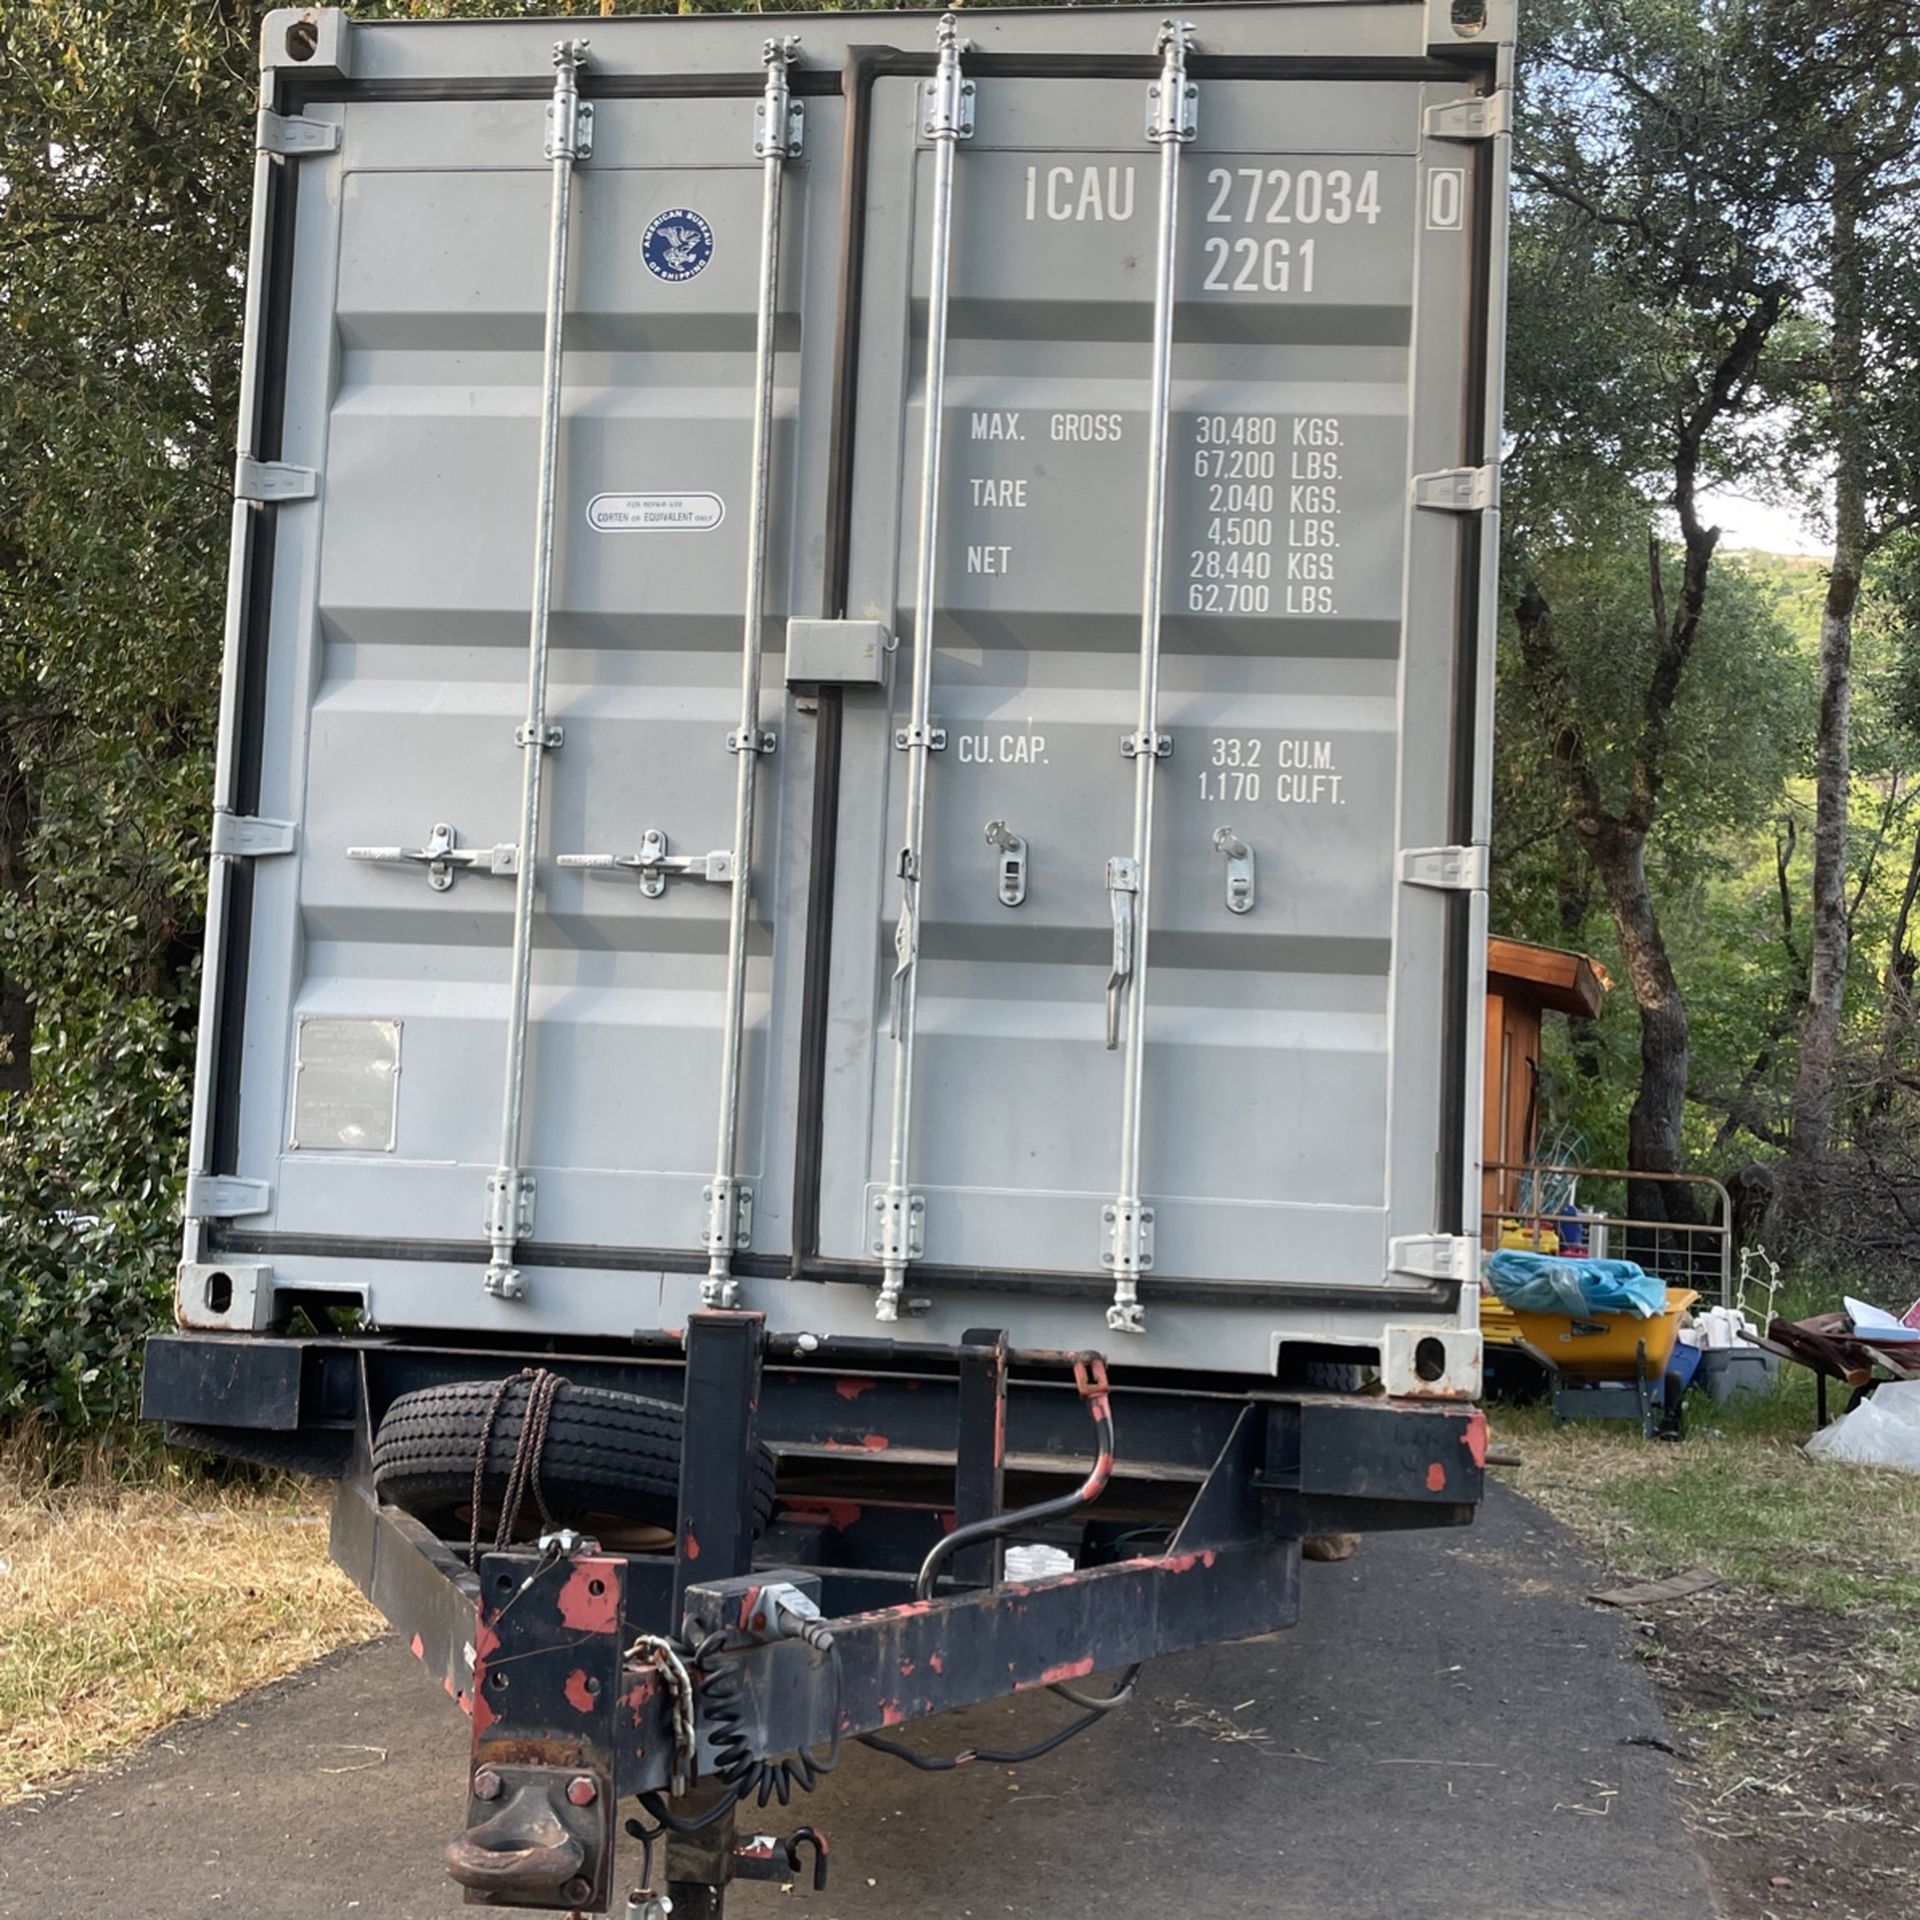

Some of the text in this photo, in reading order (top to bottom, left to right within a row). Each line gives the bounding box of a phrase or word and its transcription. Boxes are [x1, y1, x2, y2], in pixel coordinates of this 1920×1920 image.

[1025, 166, 1459, 226] ICAU 272034 0
[644, 211, 712, 249] AMERICAN BUREAU
[649, 259, 706, 281] OF SHIPPING
[1203, 237, 1315, 292] 22G1
[971, 413, 1344, 446] MAX. GROSS 30,480 KGS.
[1194, 450, 1343, 480] 67,200 LBS.
[971, 480, 1342, 514] TARE 2,040 KGS.
[597, 513, 629, 522] CORTEN
[643, 512, 693, 522] EQUIVALENT
[1288, 519, 1341, 547] LBS.
[967, 546, 1013, 574] NET
[1286, 585, 1338, 614] LBS.
[1212, 738, 1262, 767] 33.2
[1278, 740, 1335, 770] CU.M.
[1277, 774, 1346, 804] CU.FT.
